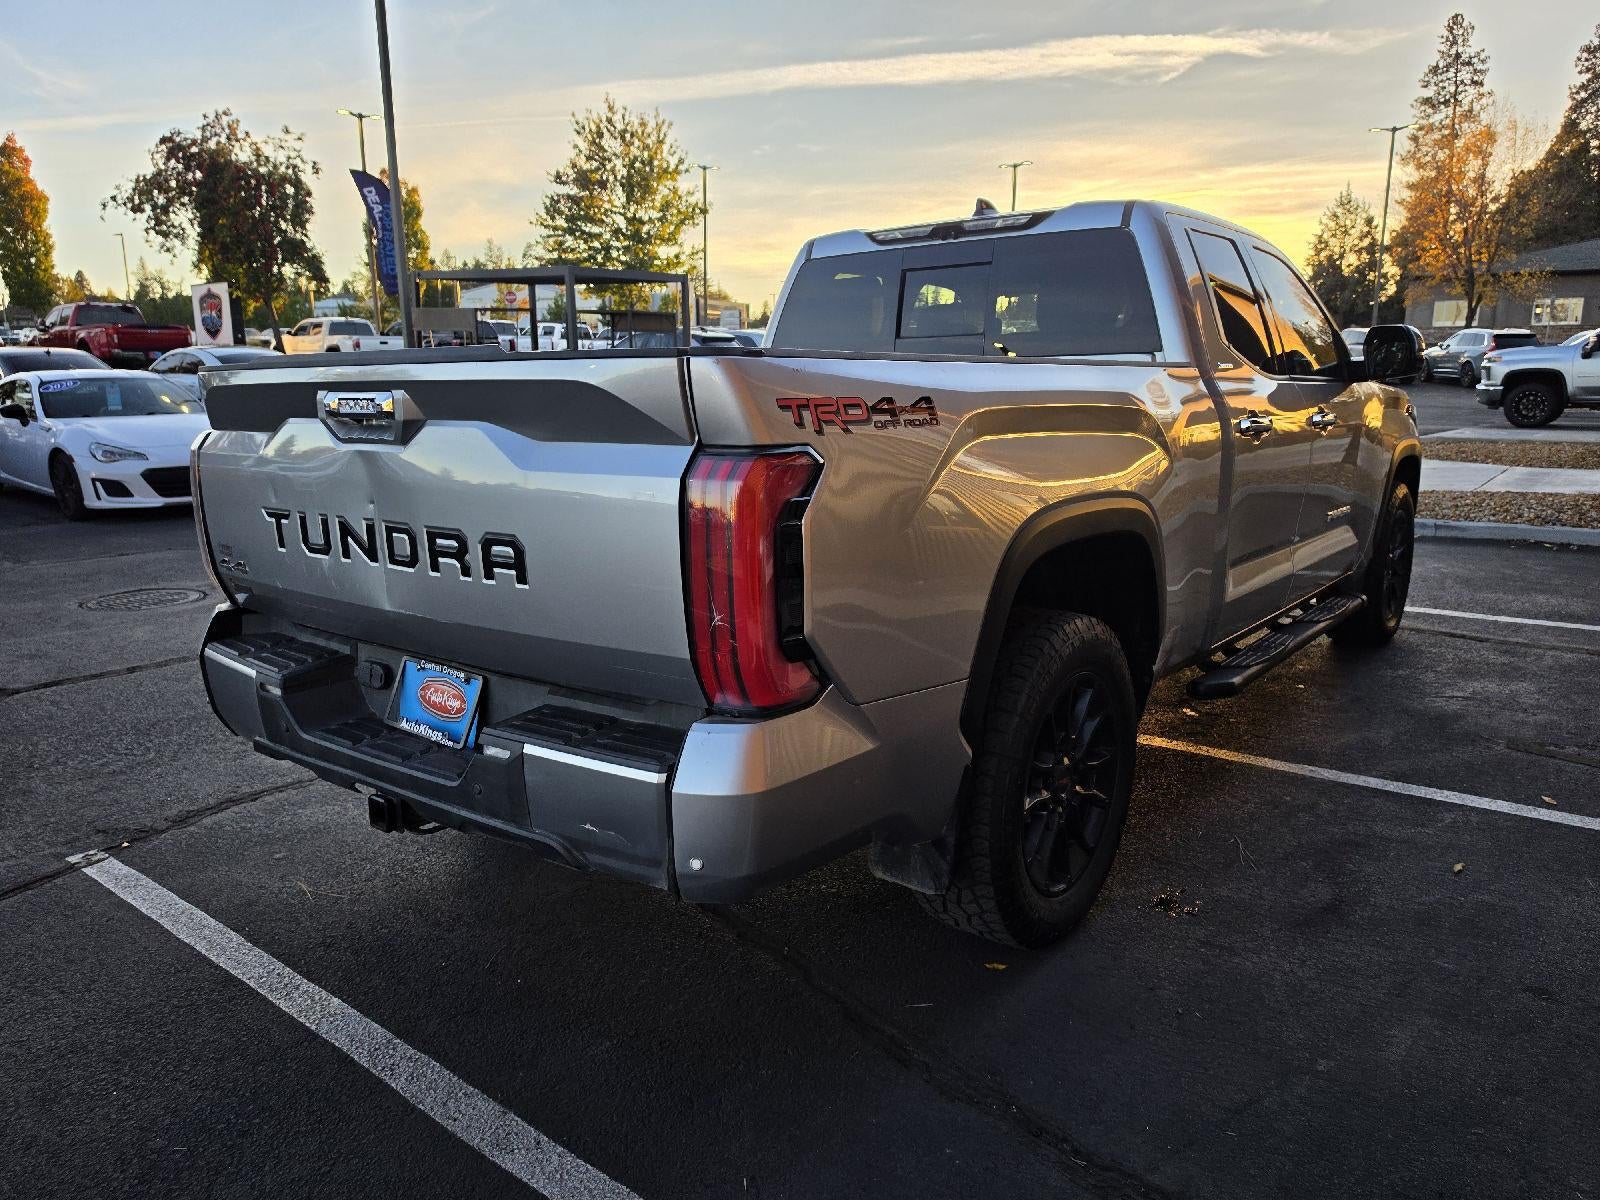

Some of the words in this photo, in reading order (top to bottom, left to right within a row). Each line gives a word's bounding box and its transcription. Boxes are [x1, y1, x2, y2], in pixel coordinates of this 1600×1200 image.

[776, 397, 872, 435] TRD
[873, 420, 902, 430] OFF
[904, 418, 939, 428] ROAD
[262, 507, 529, 589] TUNDRA
[420, 660, 441, 672] Central
[442, 666, 465, 679] Oregon
